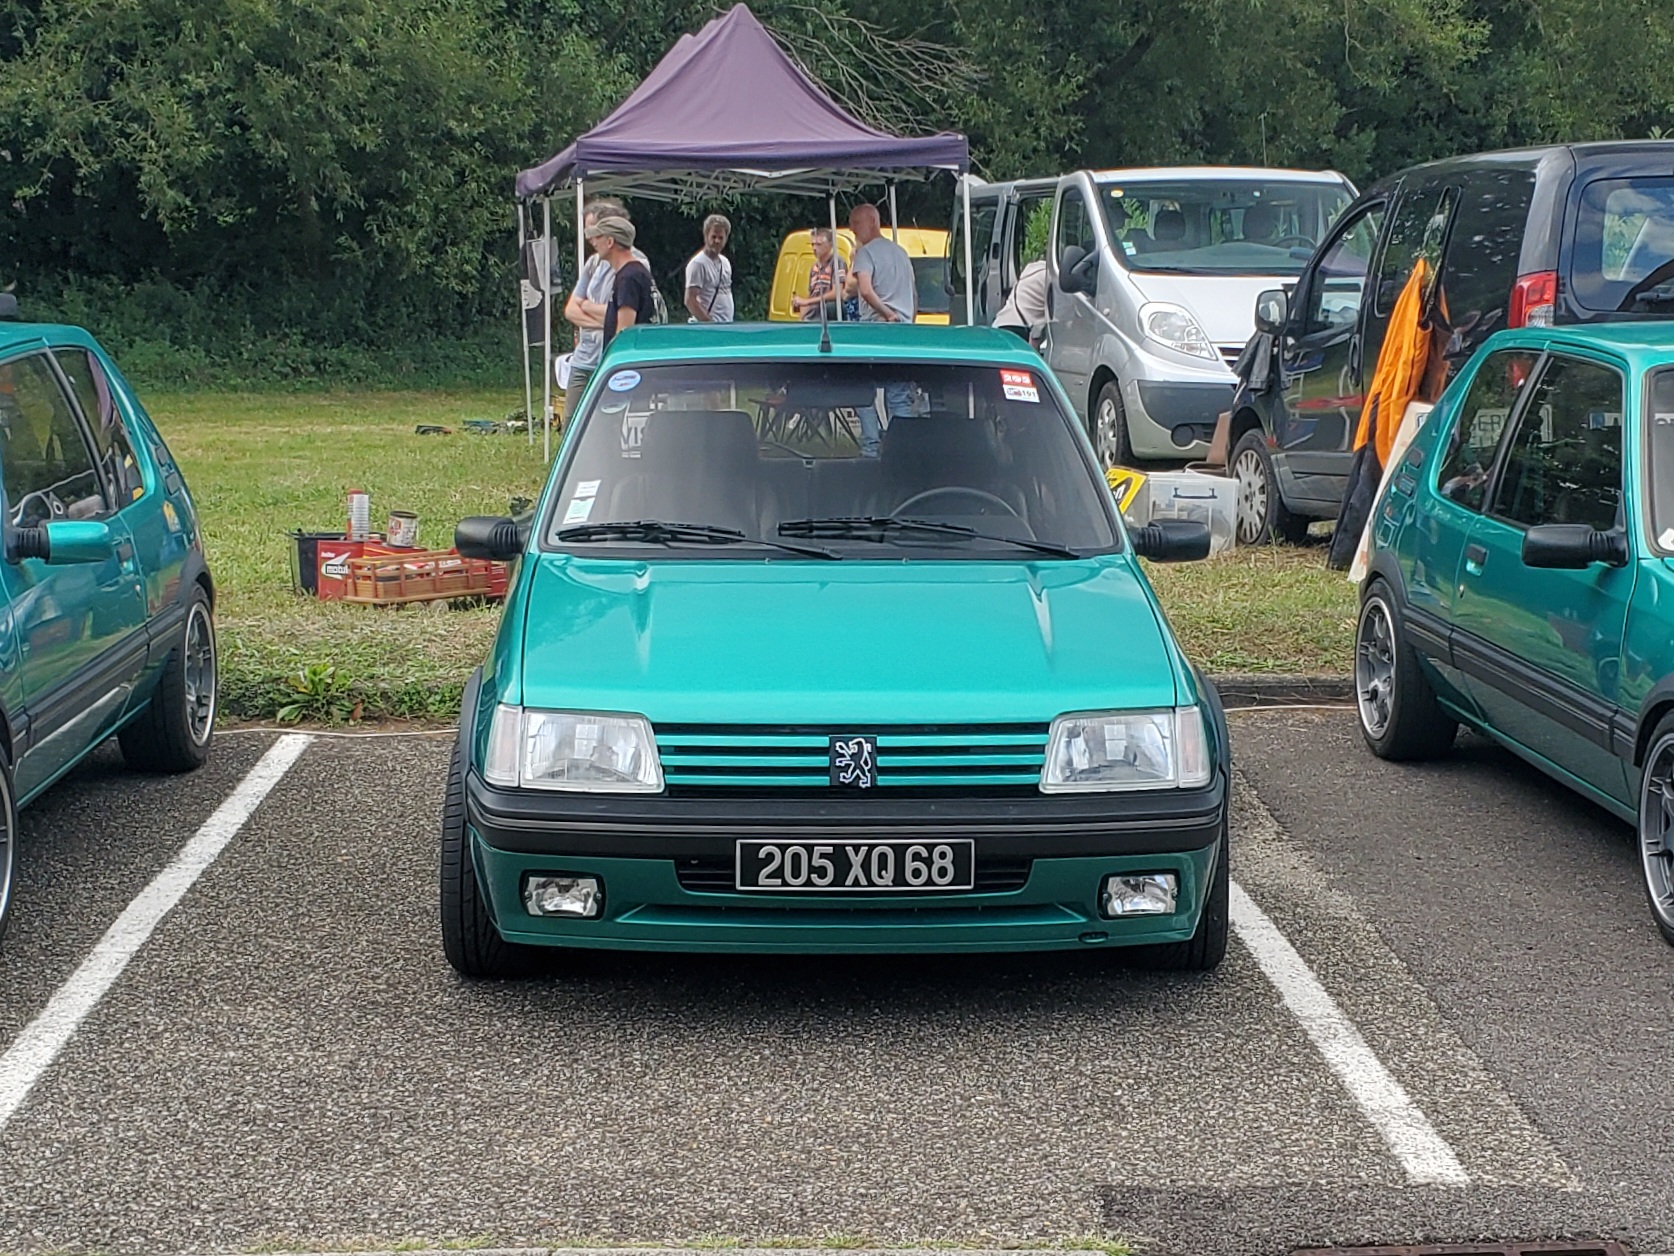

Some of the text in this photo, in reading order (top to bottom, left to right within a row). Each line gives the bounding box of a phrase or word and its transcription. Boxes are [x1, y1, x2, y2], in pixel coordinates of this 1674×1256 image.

[757, 845, 955, 886] 205 XQ 68
